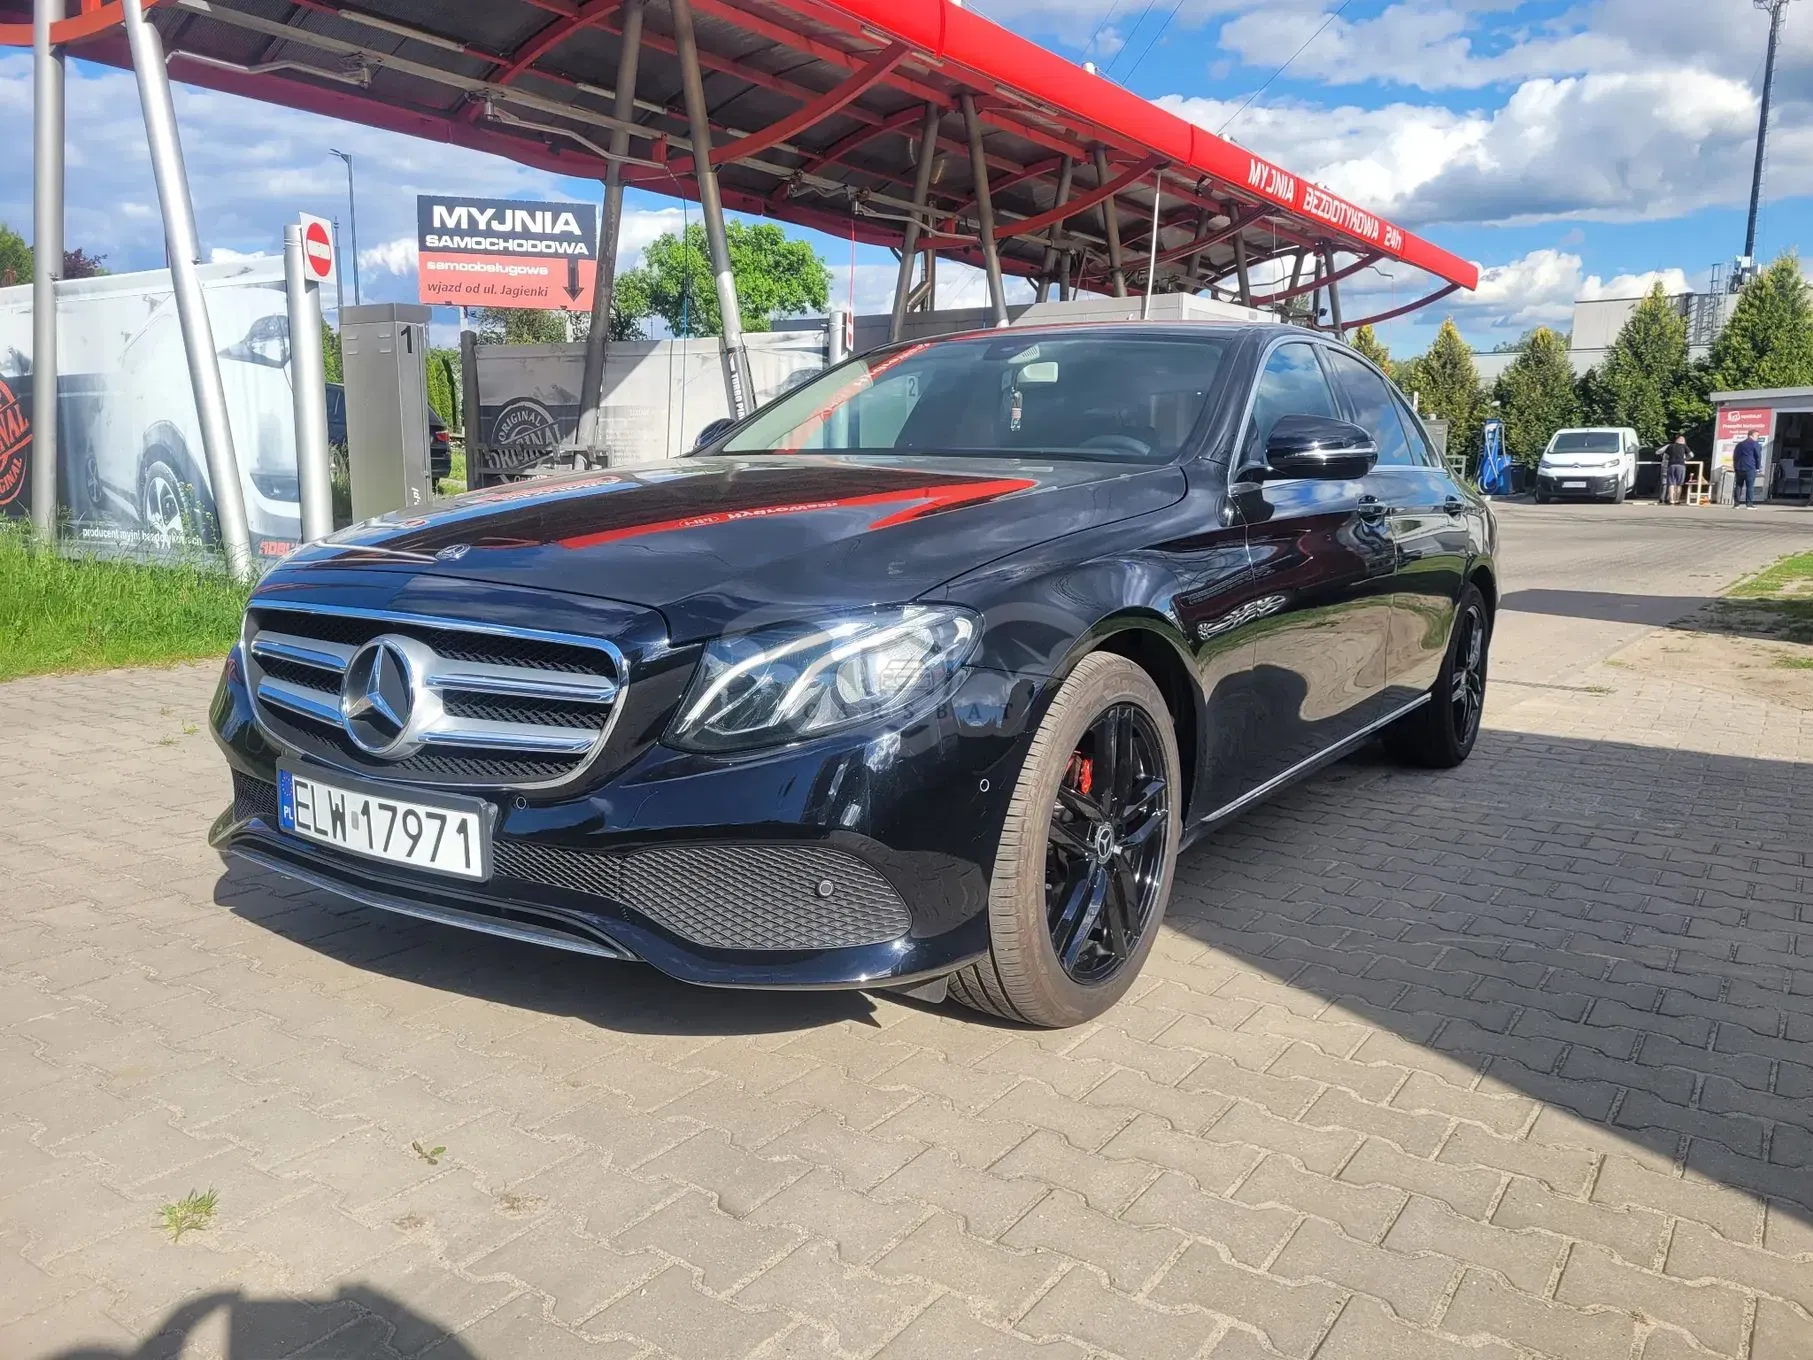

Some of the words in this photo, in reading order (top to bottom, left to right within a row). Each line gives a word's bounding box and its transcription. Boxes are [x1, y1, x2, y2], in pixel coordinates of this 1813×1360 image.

[1248, 159, 1295, 201] MYJNIA
[1303, 186, 1379, 241] BEZDOTYKOWA
[1384, 226, 1402, 251] 24h
[432, 205, 582, 236] MYJNIA
[425, 234, 589, 255] SAMOCHODOWA
[427, 282, 462, 295] wjazd
[465, 284, 480, 295] od
[484, 285, 497, 295] ul.
[500, 285, 549, 299] Jagienki
[400, 326, 413, 353] 1
[908, 377, 916, 396] 2
[498, 410, 541, 441] ORIGINAL
[82, 527, 119, 541] producent
[283, 804, 294, 820] PL
[294, 779, 347, 842] ELW
[360, 799, 471, 869] 17971
